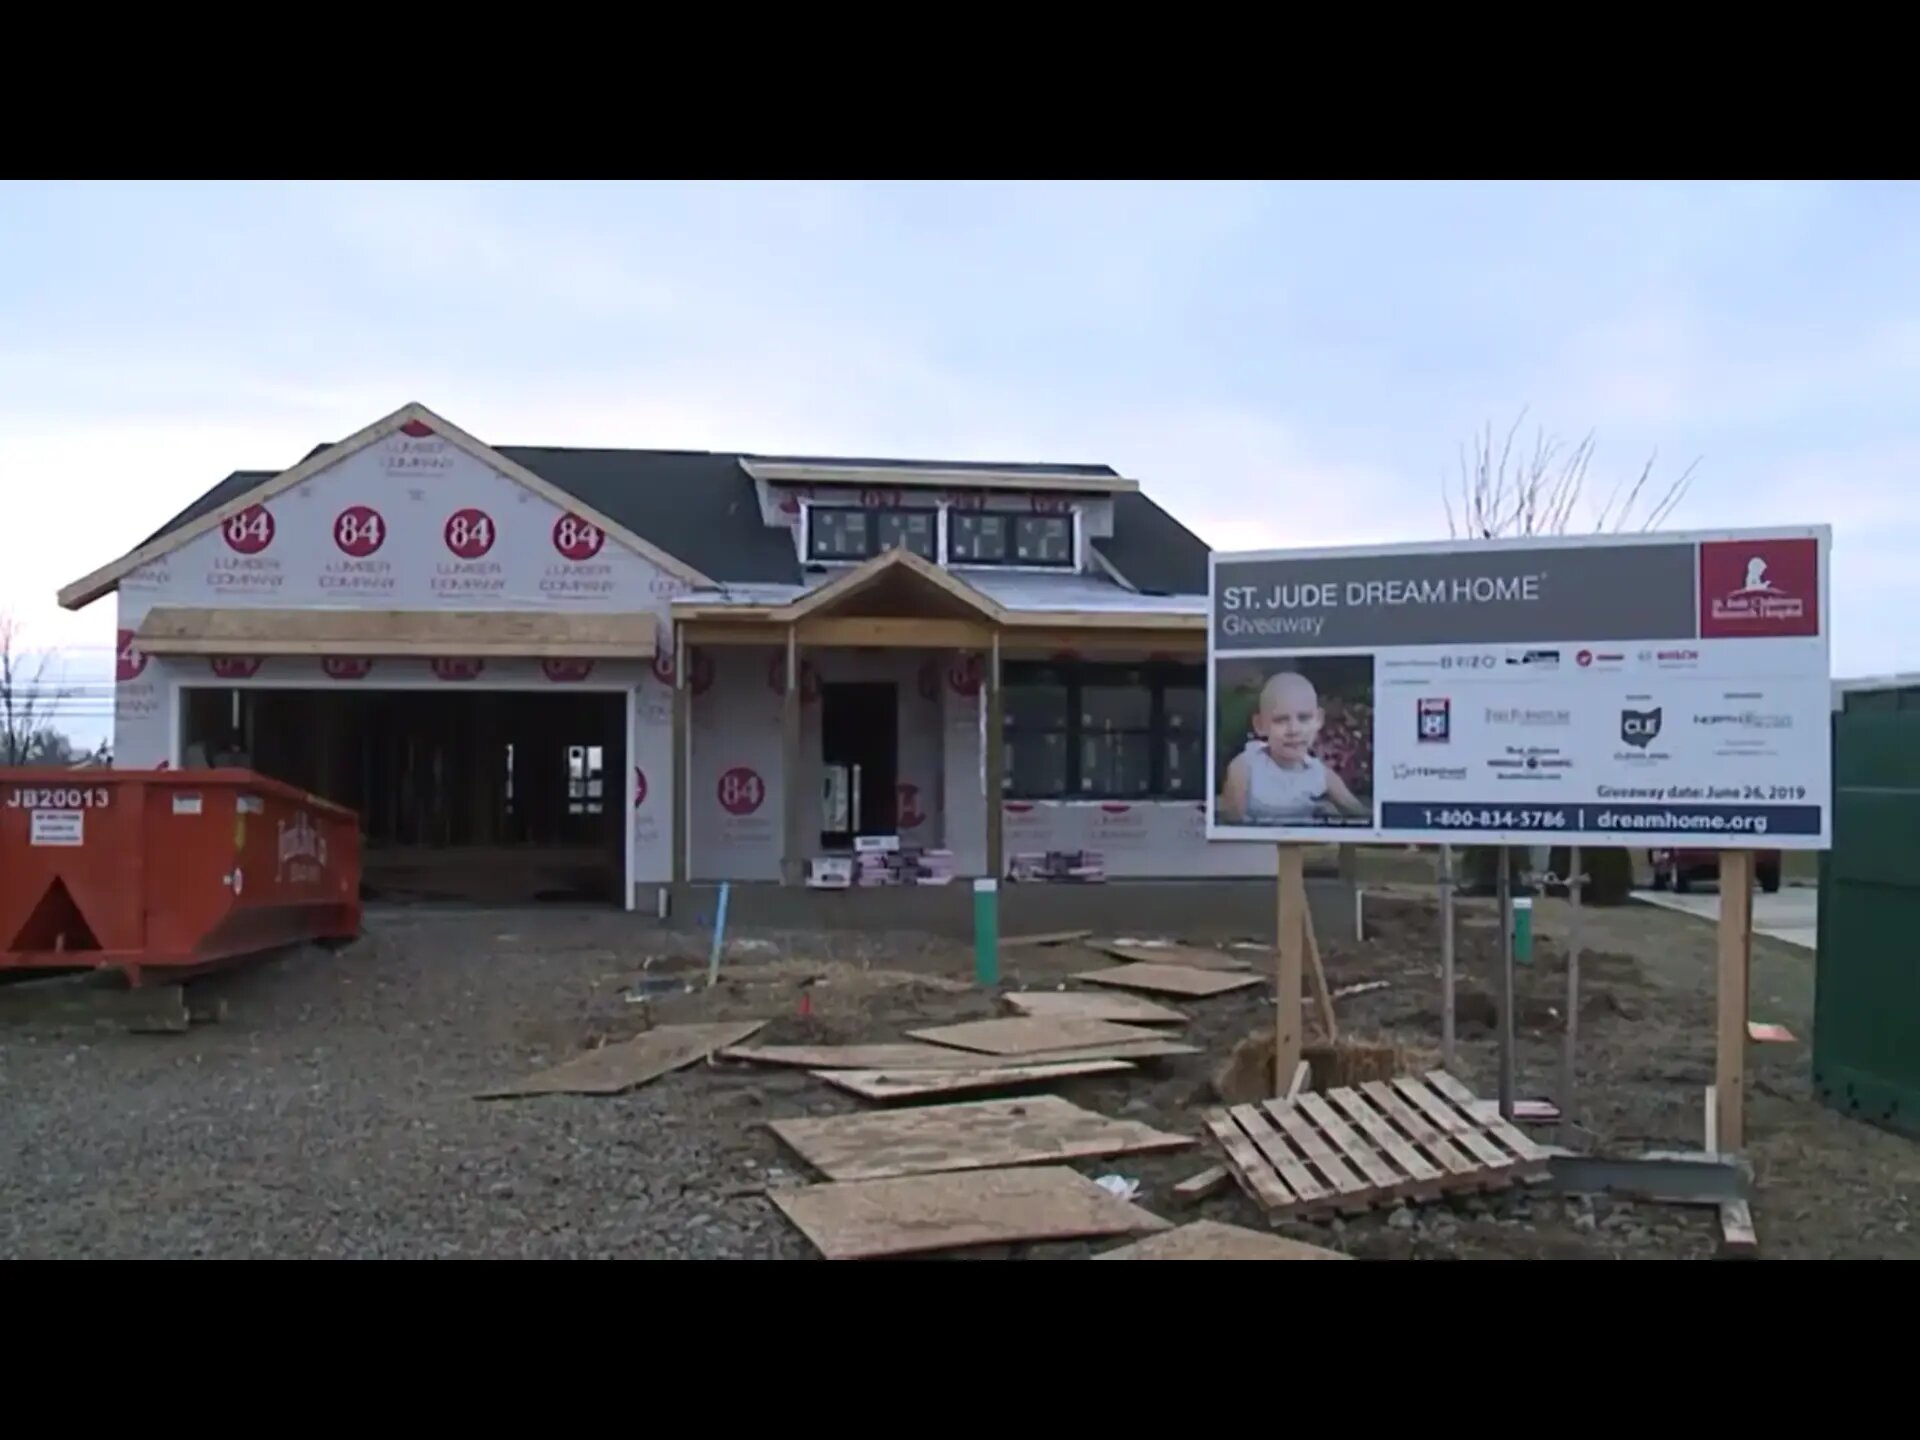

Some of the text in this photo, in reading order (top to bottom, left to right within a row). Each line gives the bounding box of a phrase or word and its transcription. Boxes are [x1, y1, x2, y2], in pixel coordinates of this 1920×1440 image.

[227, 511, 271, 543] 84
[339, 513, 381, 546] 84
[449, 516, 491, 548] 84
[557, 518, 600, 550] 84
[1223, 574, 1540, 610] ST. JUDE DREAM HOME
[1222, 613, 1325, 636] Giveaway
[7, 787, 110, 809] JB20013
[722, 775, 760, 805] 84
[1597, 784, 1664, 800] Giveaway
[1706, 785, 1740, 799] June
[1769, 785, 1806, 800] 2019
[1423, 809, 1768, 833] 1-800-834-5786 dreamhome.org
